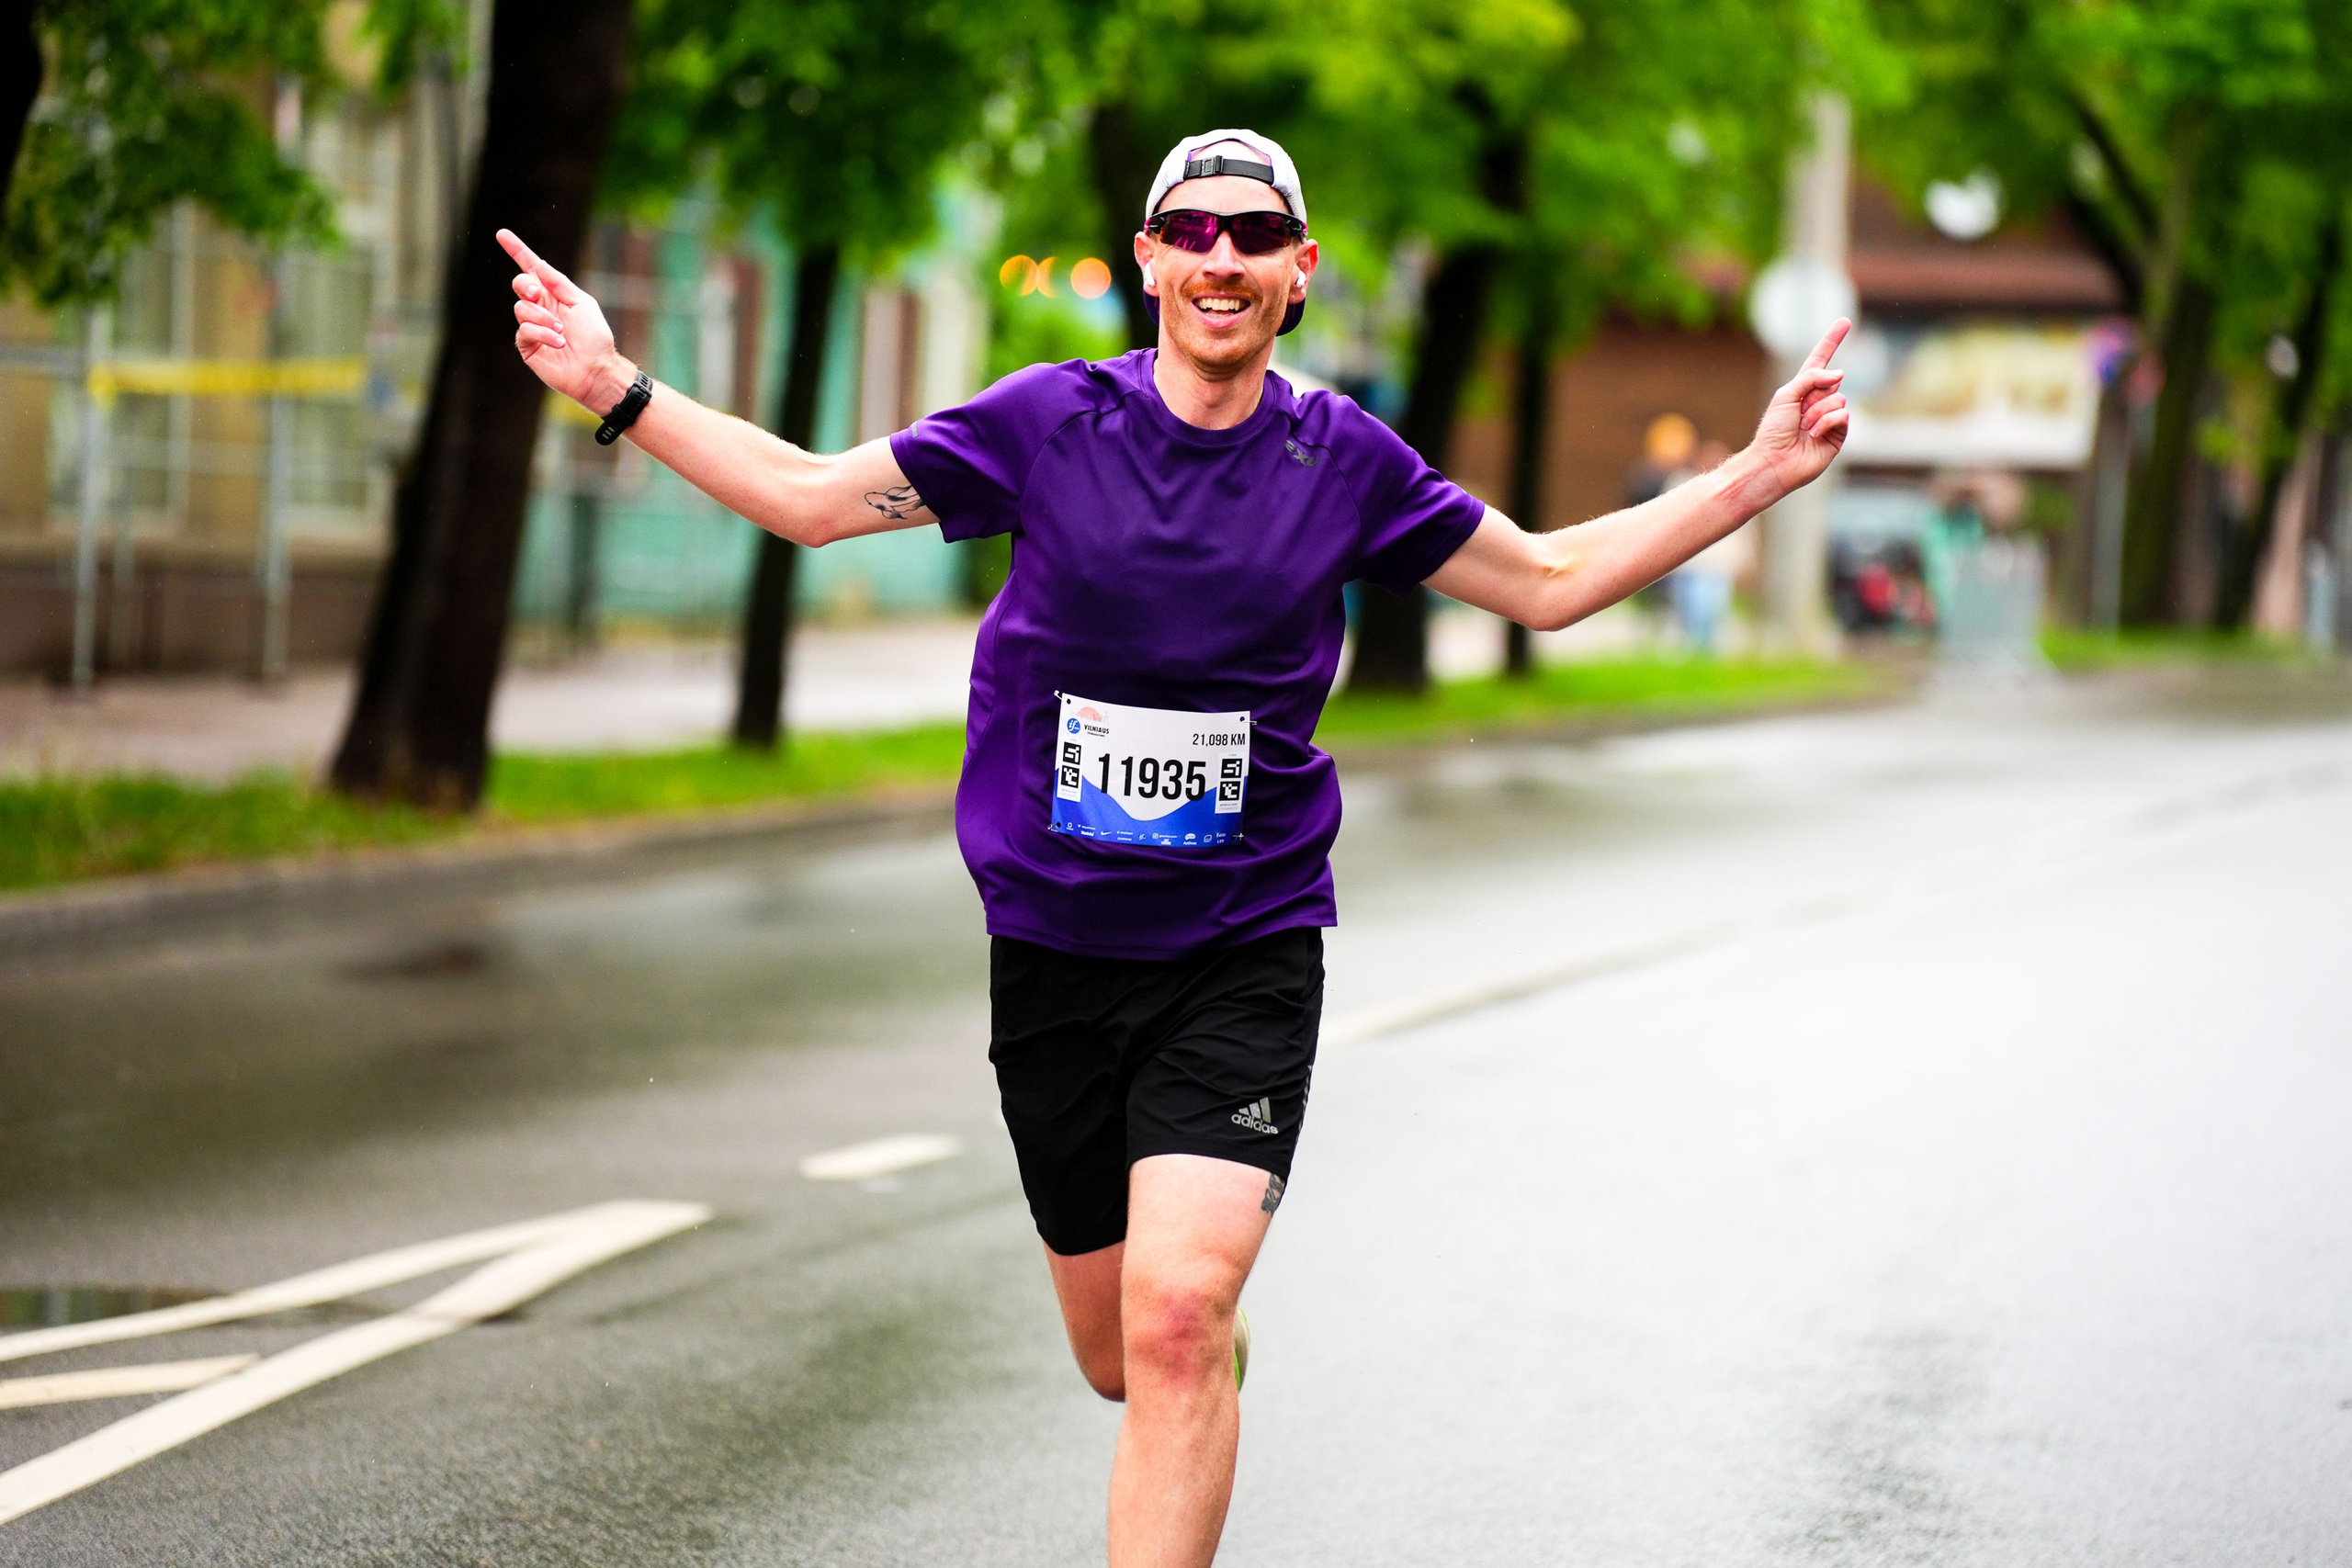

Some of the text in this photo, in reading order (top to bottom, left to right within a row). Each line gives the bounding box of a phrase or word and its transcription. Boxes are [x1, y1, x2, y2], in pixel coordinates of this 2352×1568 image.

[1084, 724, 1110, 735] VILNIAUS
[1193, 733, 1246, 747] 21,098 KM
[1098, 752, 1207, 802] 11935
[1231, 1113, 1279, 1134] adidas
